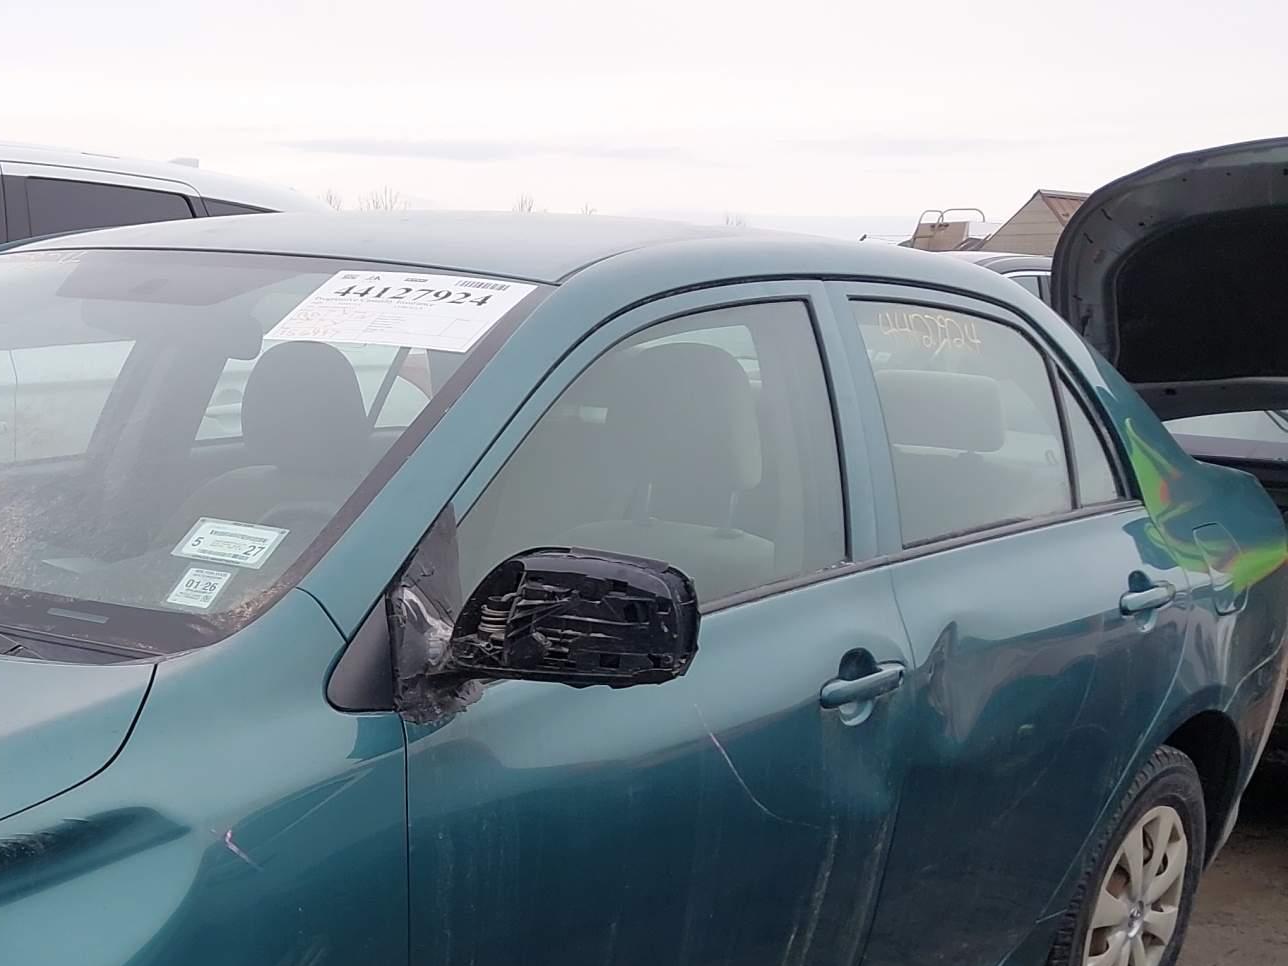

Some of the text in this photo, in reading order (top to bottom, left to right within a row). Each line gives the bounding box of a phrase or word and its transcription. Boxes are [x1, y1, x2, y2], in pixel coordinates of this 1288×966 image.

[334, 285, 492, 306] 44127924
[191, 537, 204, 547] 5
[243, 545, 265, 557] 27
